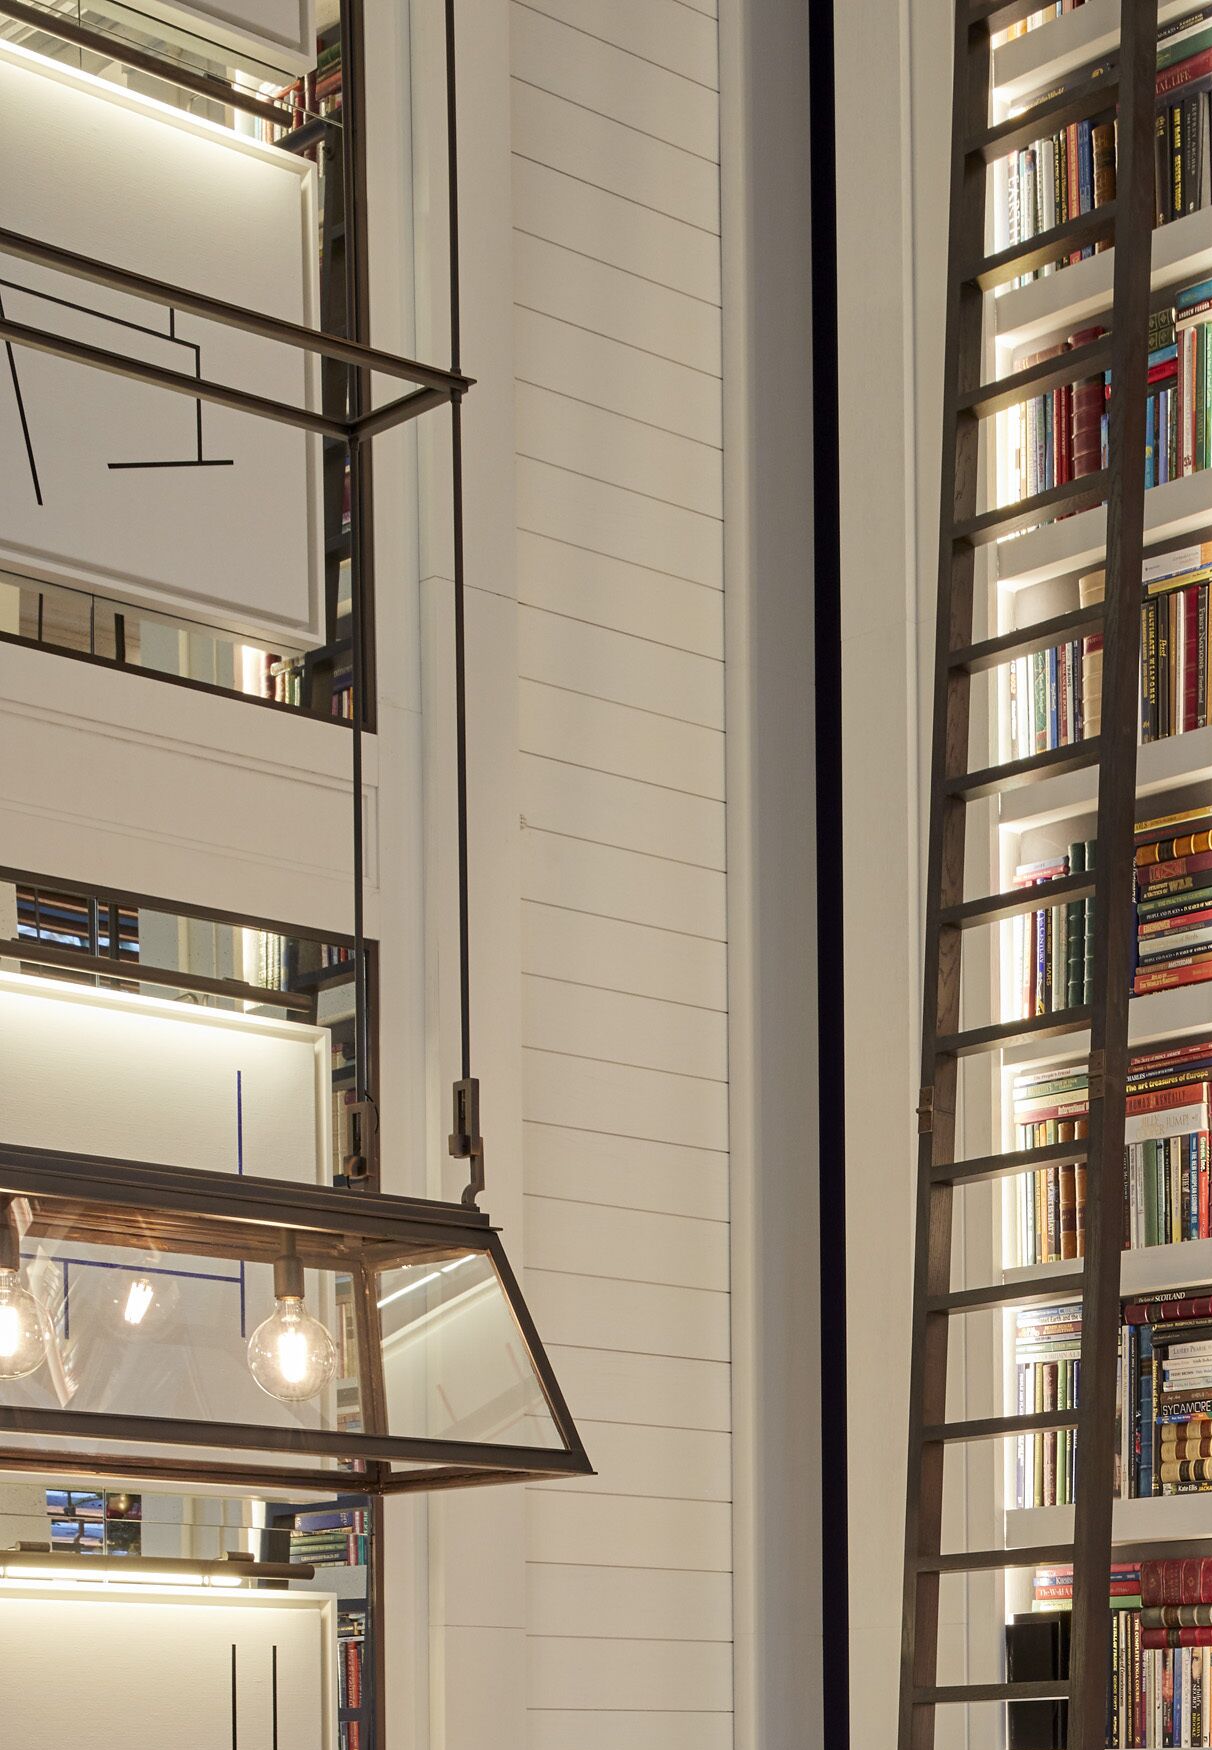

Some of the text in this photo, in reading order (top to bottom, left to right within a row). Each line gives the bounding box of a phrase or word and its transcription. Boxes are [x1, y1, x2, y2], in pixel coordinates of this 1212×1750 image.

[1137, 1082, 1148, 1090] art
[1149, 1076, 1178, 1088] treasures
[1185, 1070, 1209, 1081] Europe
[1162, 1400, 1212, 1416] SYCAMORE
